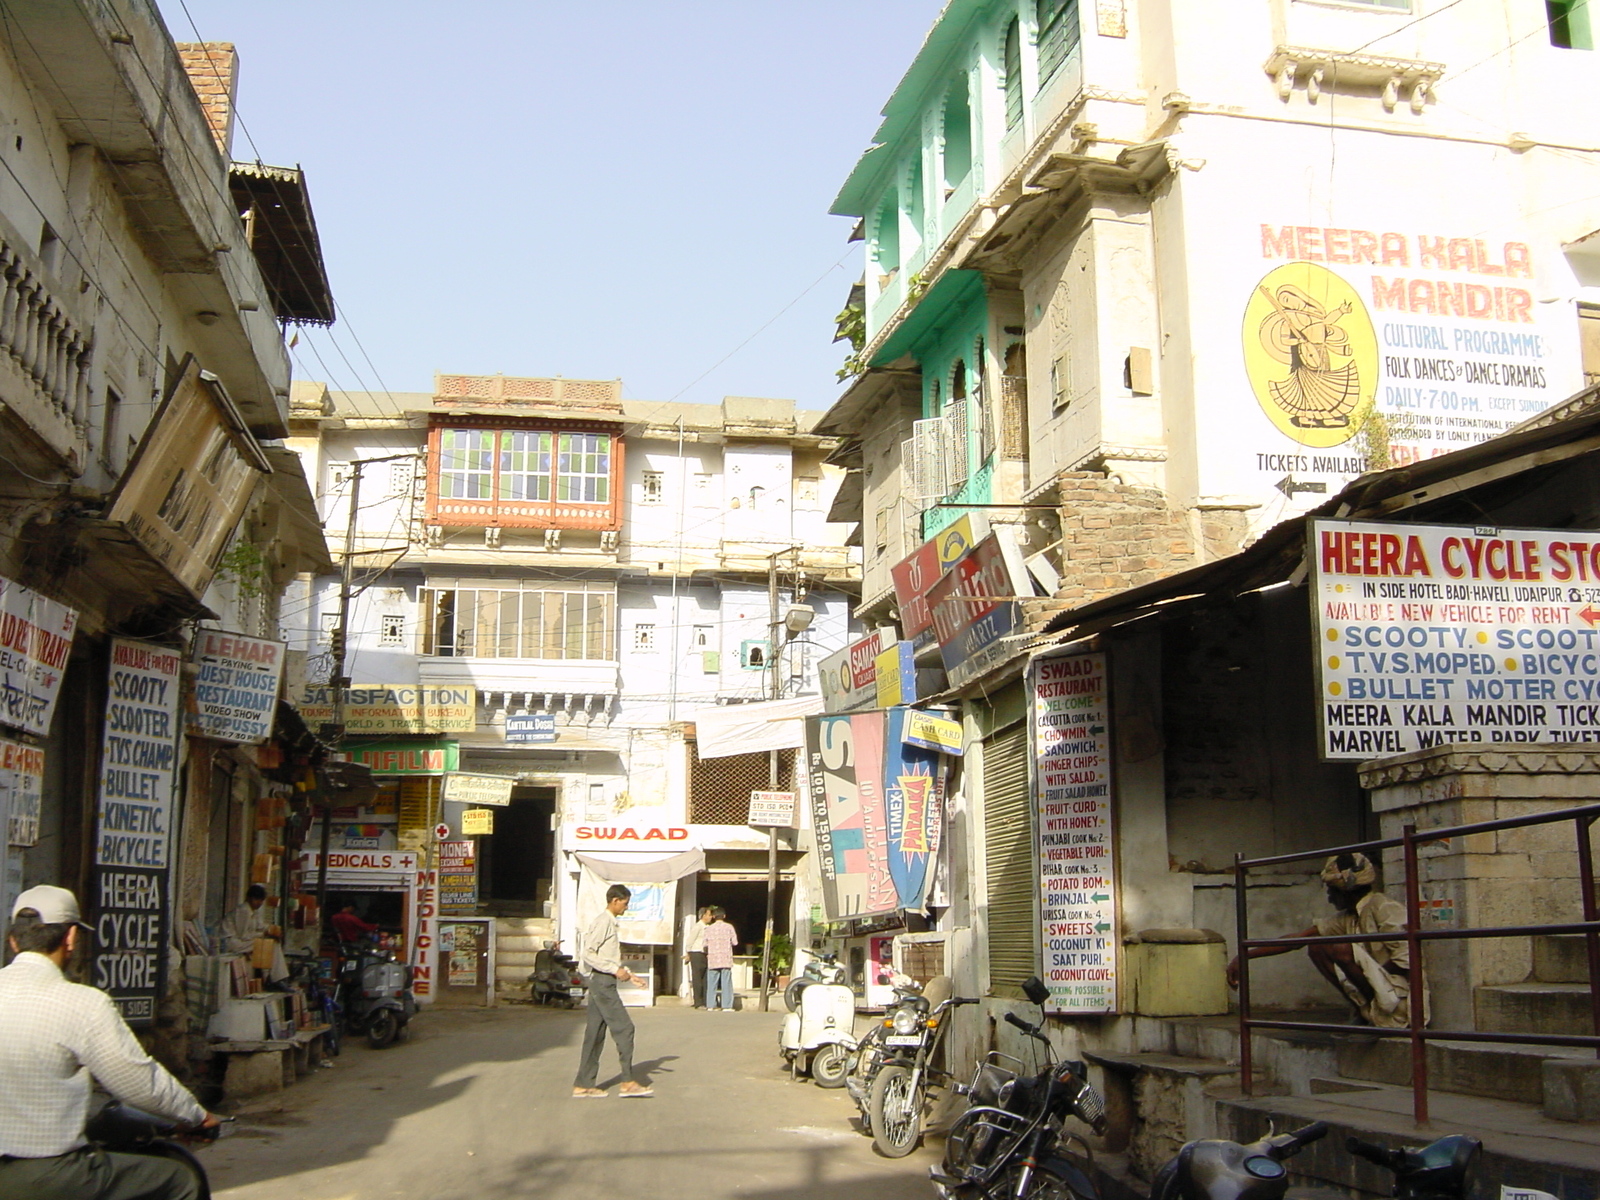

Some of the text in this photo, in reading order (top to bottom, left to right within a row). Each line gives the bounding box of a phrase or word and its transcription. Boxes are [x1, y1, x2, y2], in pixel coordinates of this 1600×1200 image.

[1259, 223, 1536, 280] MEERA KALA
[1370, 275, 1536, 325] MANDIR
[1383, 323, 1449, 351] CULTURAL
[1385, 356, 1412, 379] FOLK
[1414, 358, 1456, 382] DANCES
[1464, 361, 1501, 386] DANCE
[1502, 363, 1547, 389] DRAMAS
[1488, 396, 1517, 412] EXCEPT
[1434, 415, 1444, 427] OF
[1446, 417, 1503, 430] INTERNATIONAL
[1435, 430, 1470, 442] BY LONLY
[1256, 453, 1309, 473] TICKETS
[1321, 530, 1433, 578] HEERA
[1440, 536, 1543, 582] CYCLE
[1363, 582, 1376, 598] IN
[1380, 582, 1407, 599] SIDE
[1409, 583, 1444, 600] HOTEL
[1401, 603, 1434, 622] NEW
[1440, 603, 1493, 624] VEHICLE
[1498, 607, 1526, 624] FOR
[1531, 607, 1571, 625] RENT
[203, 634, 278, 665] LEHAR
[1497, 629, 1600, 650] SCOOT
[113, 644, 151, 671] AVAILABLE
[161, 653, 180, 677] RENT
[220, 658, 254, 671] PAYING
[1040, 659, 1093, 680] SWAAD
[1521, 654, 1600, 676] BICYC
[114, 670, 169, 707] SCOOTY.
[234, 670, 277, 693] HOUSE
[1037, 676, 1102, 699] RESTAURANT
[1347, 678, 1455, 700] BULLET
[1466, 678, 1556, 701] MOTER
[196, 684, 277, 713] RESTAURANT
[110, 703, 173, 739] SCOOTER.
[204, 704, 262, 721] VIDEO SHOW
[301, 707, 467, 718] TOURIS INFORMATION BUREAU
[1038, 713, 1071, 727] CALCUTTA
[1327, 704, 1392, 727] MEERA
[1402, 704, 1455, 727] KALA
[1466, 704, 1547, 727] MANDIR
[345, 717, 471, 730] ORLD & TRAVEL SERVICE
[913, 721, 936, 734] CASH
[937, 728, 961, 740] CARD
[1044, 740, 1100, 757] SANDWICH.
[1329, 729, 1407, 753] MARVEL
[1044, 758, 1072, 772] FINGER
[105, 768, 160, 802] BULLET.
[814, 771, 825, 795] 100
[1046, 770, 1099, 787] WITH SALAD.
[1045, 789, 1064, 801] FRUIT
[1065, 786, 1086, 799] SALAD
[103, 801, 165, 835] KINETIC.
[817, 800, 828, 816] TO
[819, 719, 867, 917] SALE
[889, 788, 903, 837] TIMEX
[575, 826, 689, 840] SWAAD
[1046, 815, 1102, 831] WITH HONEY.
[819, 819, 832, 852] 1500
[1042, 832, 1087, 847] PUNJABI COOK
[101, 834, 165, 868] BICYCLE.
[440, 842, 475, 858] MONEY
[1047, 845, 1107, 861] VEGETABLE PURI.
[824, 856, 836, 881] OFF
[1042, 863, 1080, 876] BIHAR COOK
[100, 872, 161, 910] HEERA
[1047, 876, 1106, 891] POTATO BOM.
[1043, 908, 1083, 922] URISSA COOK
[98, 912, 160, 949] CYCLE
[1049, 922, 1096, 936] SWEETS.
[1049, 937, 1106, 951] COCONUT KI
[1052, 953, 1106, 966] SAAT PURI.
[96, 953, 158, 990] STORE
[1050, 968, 1086, 981] COCONUT
[1075, 984, 1105, 995] POSSIBLE
[127, 1000, 150, 1016] SIDE
[1055, 997, 1068, 1007] FOR
[1069, 996, 1081, 1007] ALL
